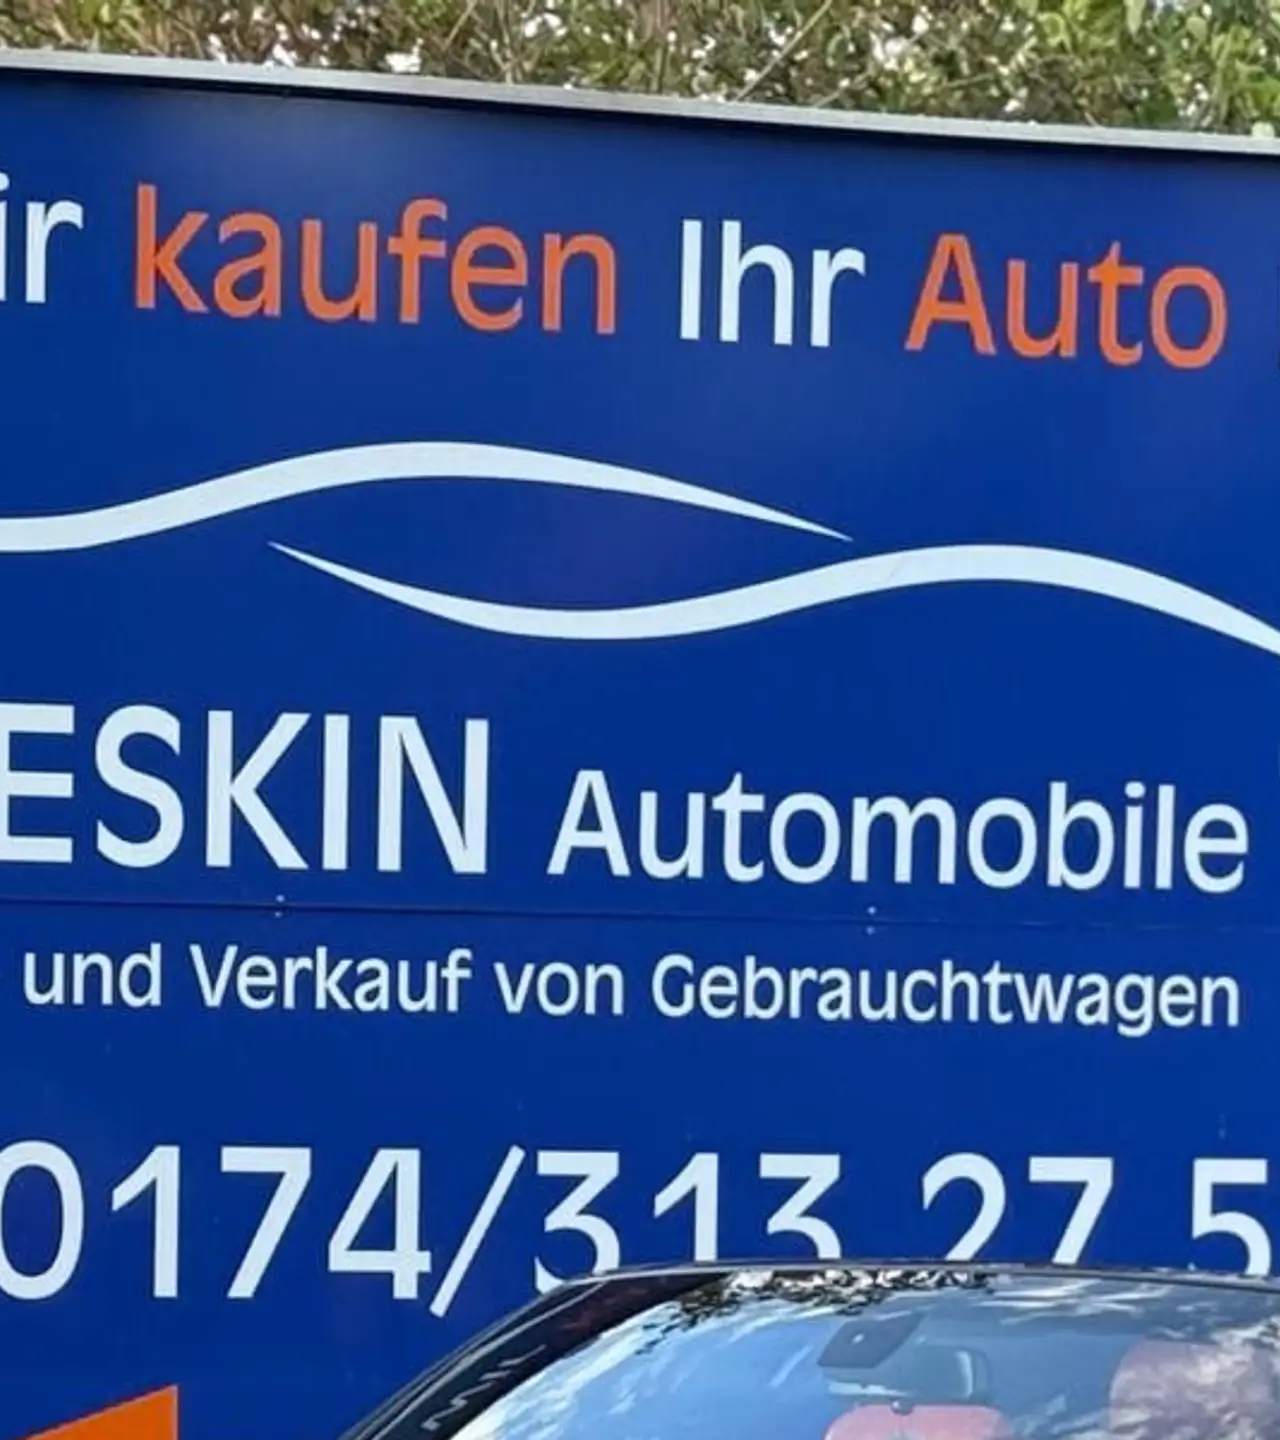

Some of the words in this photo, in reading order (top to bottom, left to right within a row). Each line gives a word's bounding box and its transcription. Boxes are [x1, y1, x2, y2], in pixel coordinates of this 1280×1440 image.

[135, 183, 617, 335] kaufen
[680, 219, 865, 347] Ihr
[904, 232, 1228, 370] Auto
[547, 770, 1248, 893] Automobile
[24, 943, 161, 1007] und
[190, 945, 472, 1012] Verkauf
[494, 962, 623, 1015] von
[652, 954, 1239, 1037] Gebrauchtwagen
[922, 1152, 1114, 1267] 27
